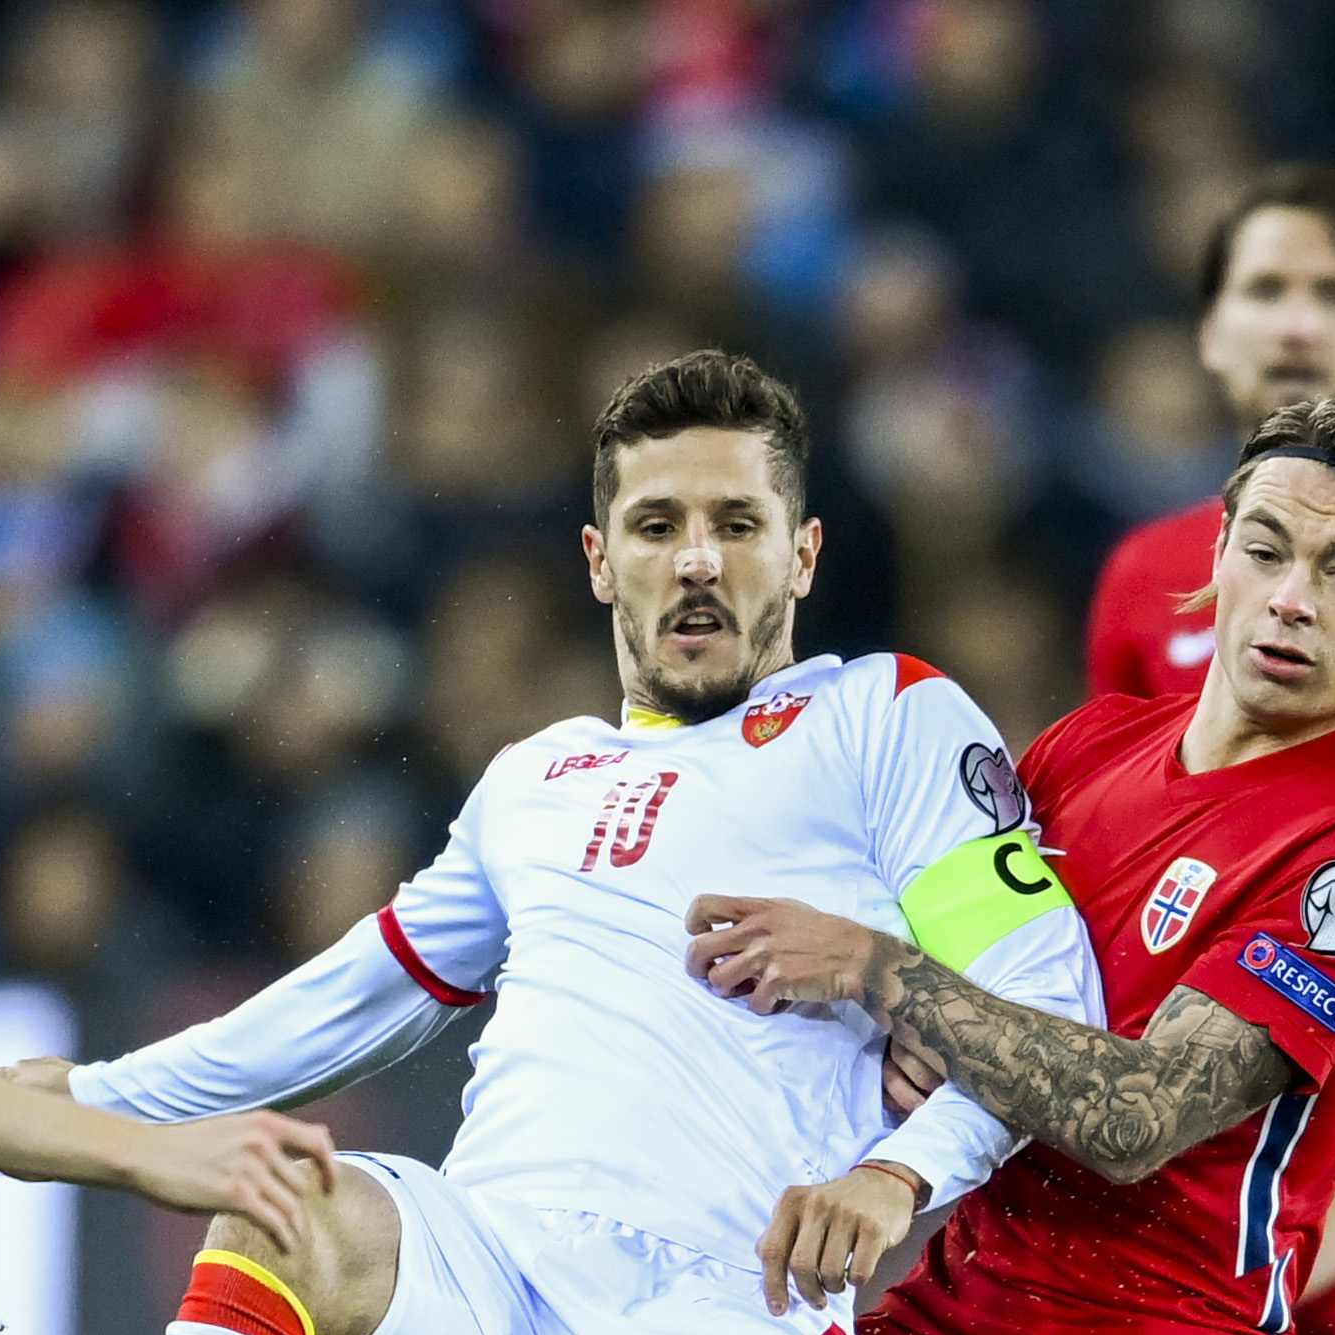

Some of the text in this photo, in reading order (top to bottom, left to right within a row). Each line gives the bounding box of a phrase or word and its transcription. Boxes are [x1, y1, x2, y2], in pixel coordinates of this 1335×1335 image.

[544, 750, 630, 781] LEGEA
[576, 771, 679, 872] 10
[994, 842, 1053, 895] C
